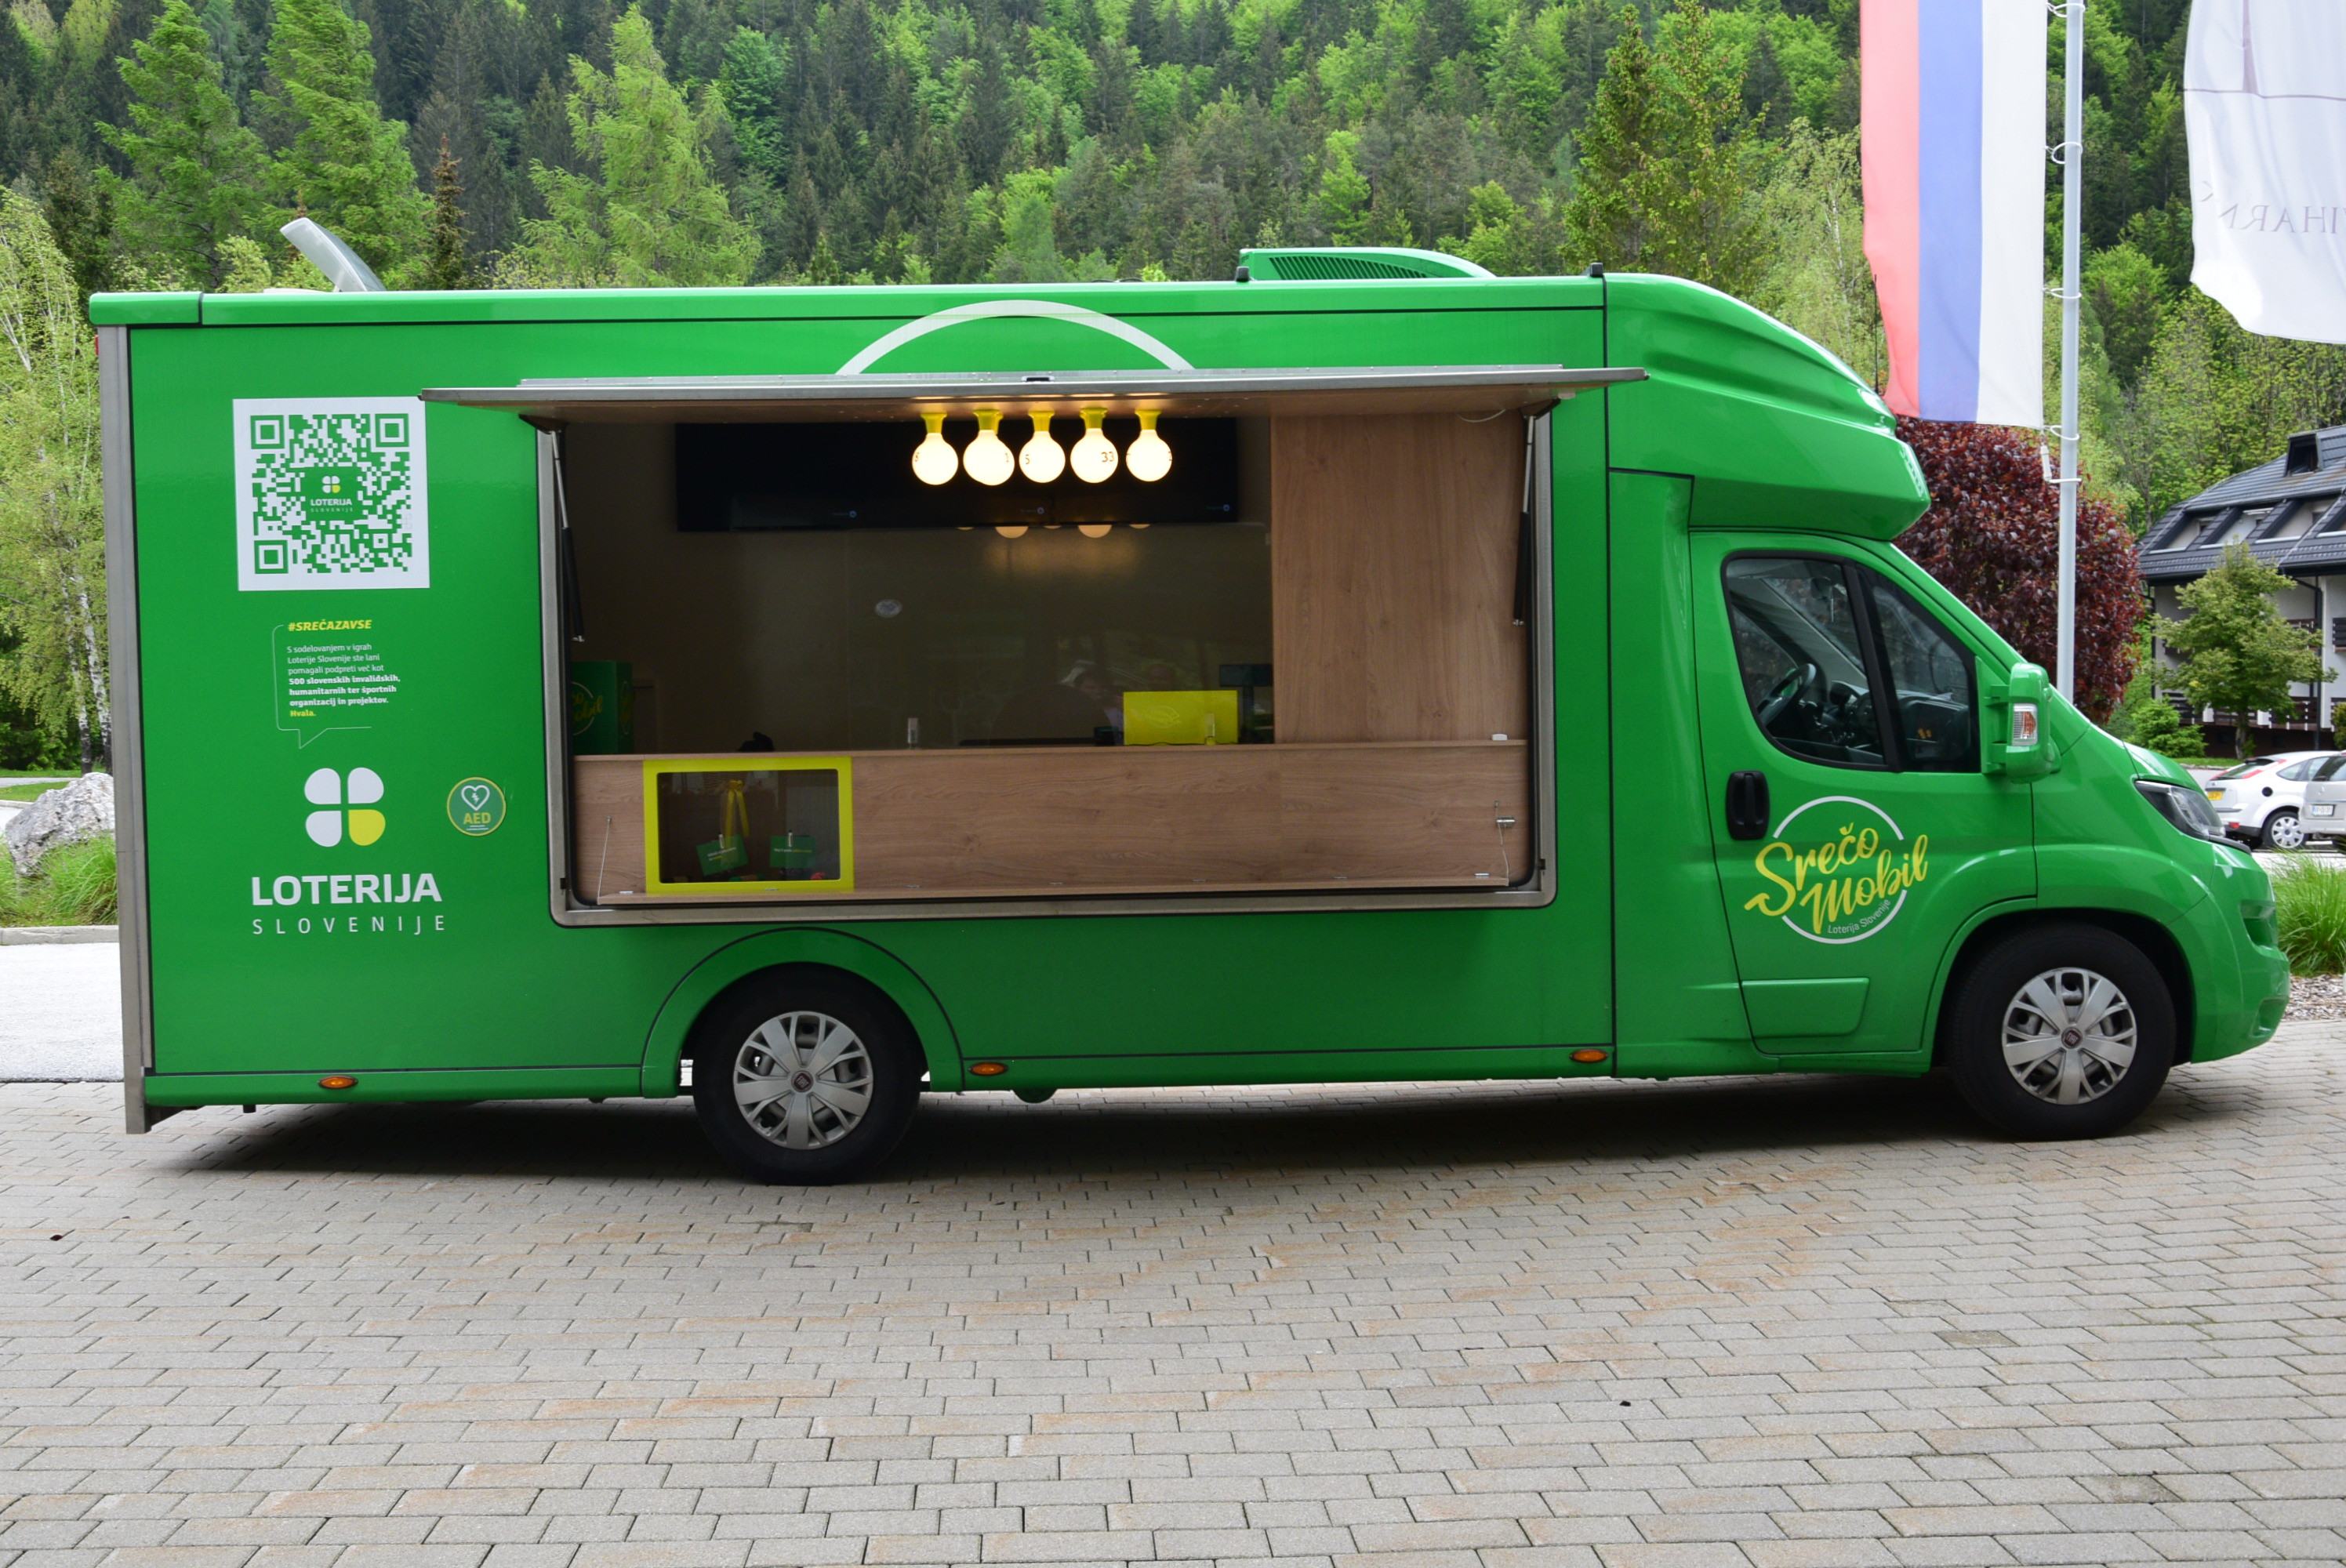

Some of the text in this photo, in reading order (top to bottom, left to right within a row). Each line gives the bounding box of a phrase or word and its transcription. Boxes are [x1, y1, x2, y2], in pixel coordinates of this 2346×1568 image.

[1025, 454, 1030, 464] 5
[1101, 451, 1114, 463] 33
[289, 619, 372, 631] #SREČAZAVSE
[294, 644, 345, 653] sodelovanjem
[352, 643, 372, 652] igrah
[288, 656, 316, 665] Loterije
[318, 655, 351, 663] Slovenije
[288, 666, 323, 676] pomagali
[325, 665, 357, 674] podpreti
[307, 676, 350, 684] slovenskih
[351, 674, 401, 684] invalidskih,
[289, 687, 346, 695] humanitarnih
[361, 685, 397, 695] športnih
[289, 698, 336, 708] organizacij
[347, 696, 389, 706] projektov.
[463, 812, 492, 824] AED
[1744, 822, 1879, 916] Srečo
[252, 873, 443, 906] LOTERIJA
[1799, 834, 1928, 935] Mobil
[1828, 898, 1891, 934] Loterija Slovenije
[252, 915, 445, 935] SLOVENIJE
